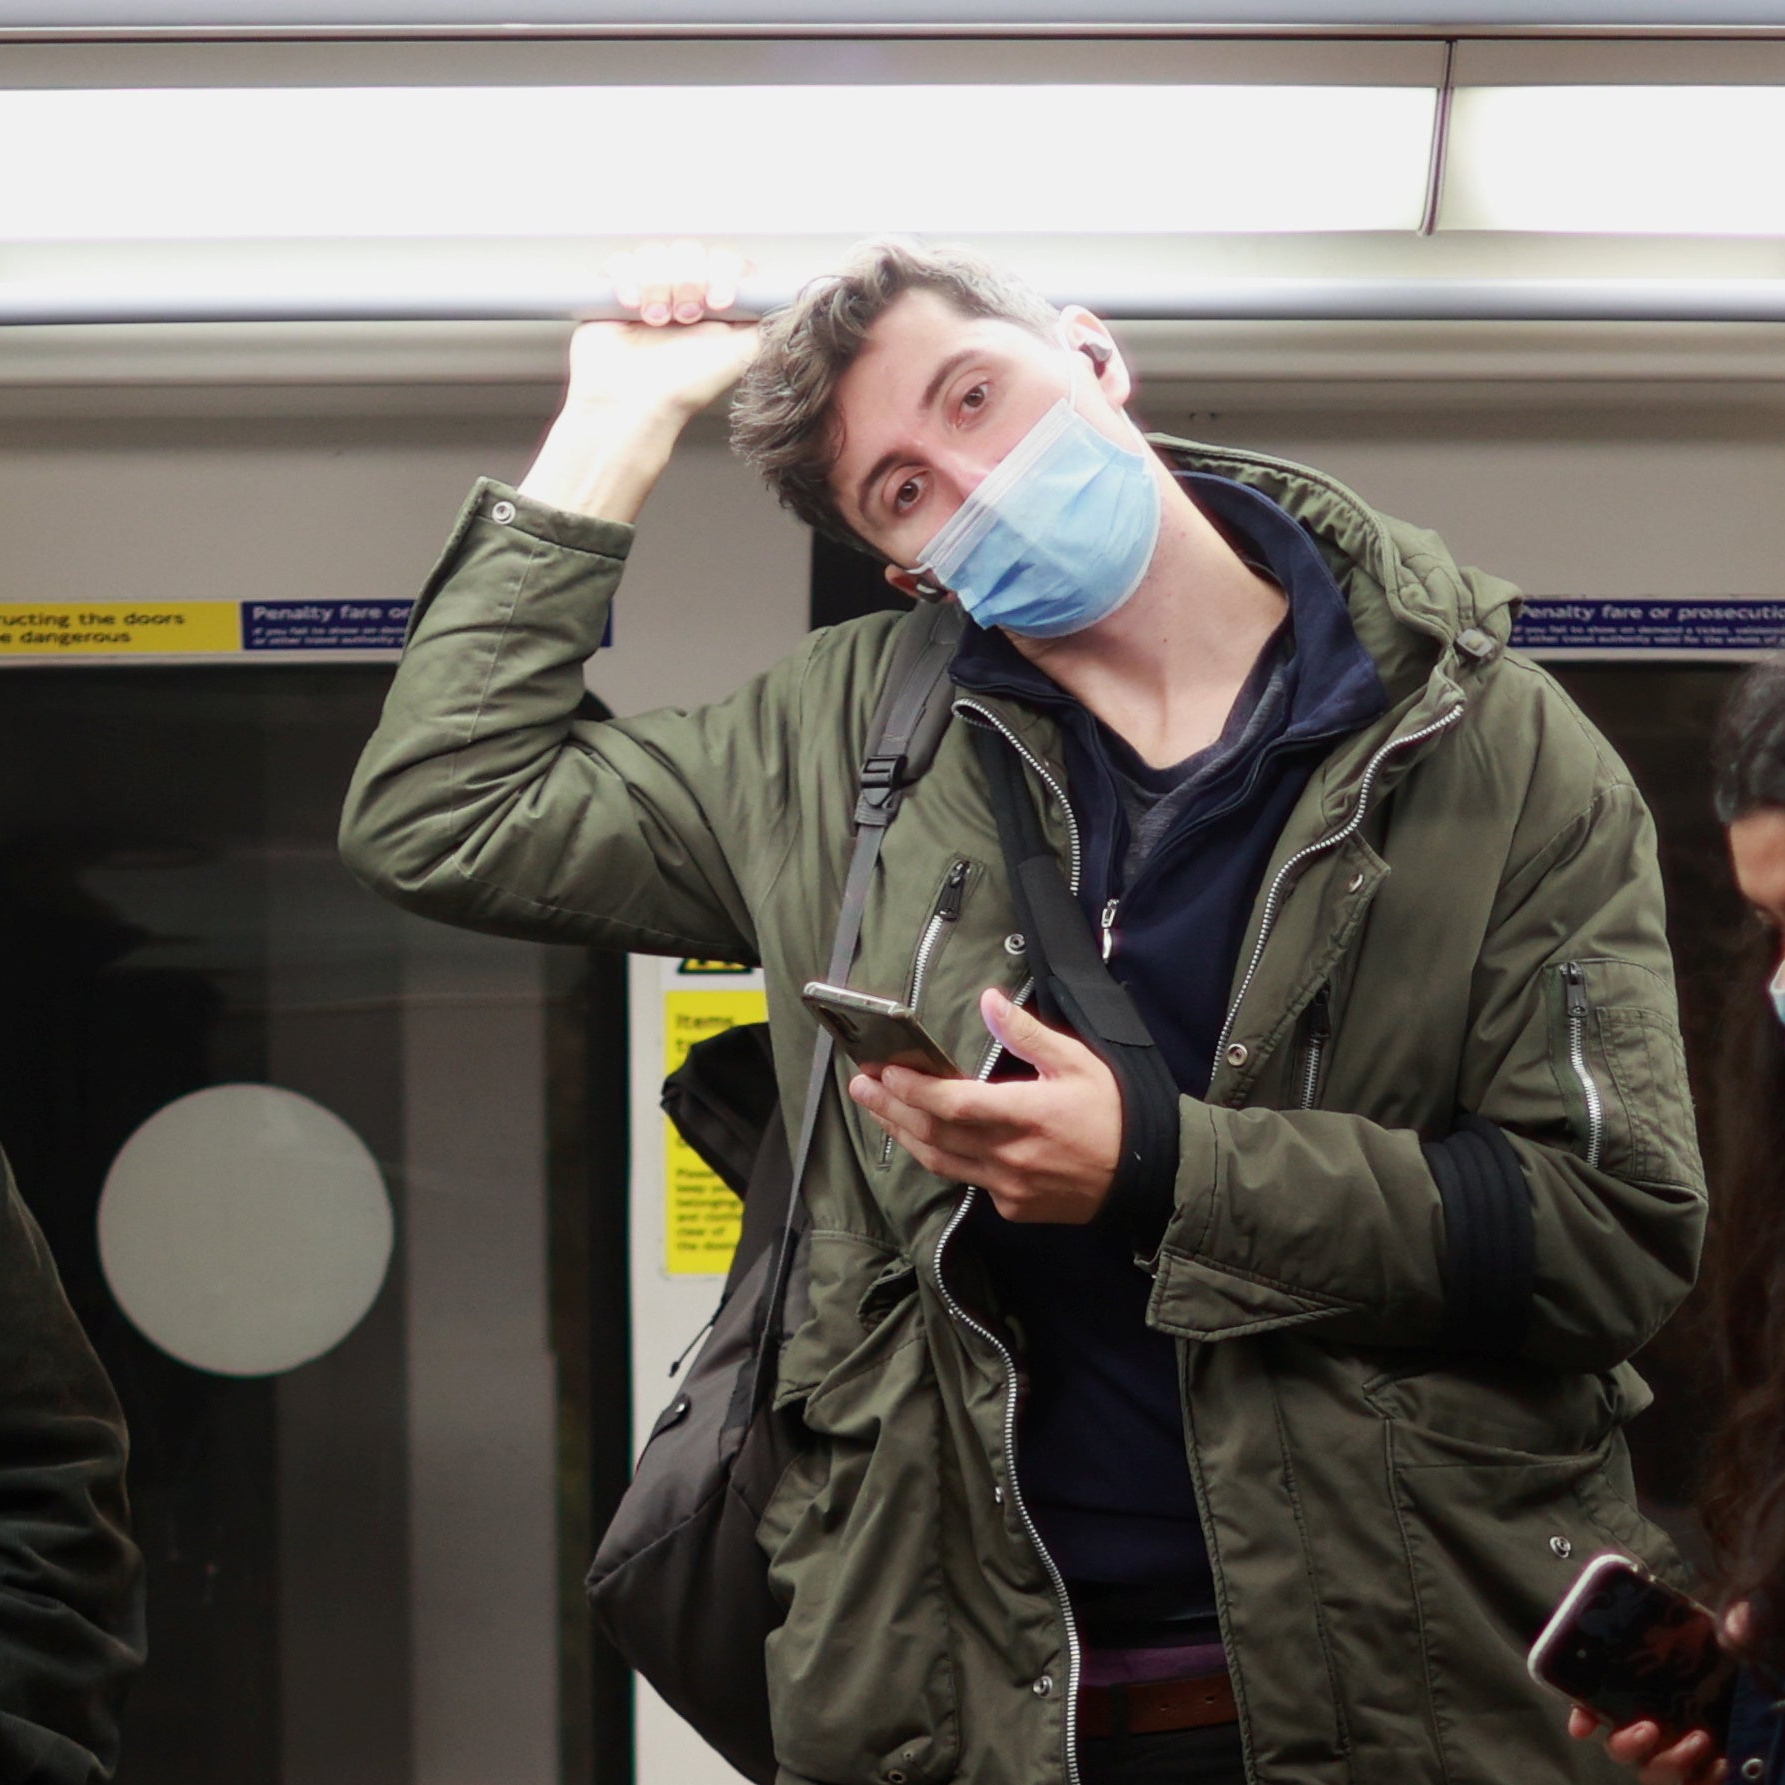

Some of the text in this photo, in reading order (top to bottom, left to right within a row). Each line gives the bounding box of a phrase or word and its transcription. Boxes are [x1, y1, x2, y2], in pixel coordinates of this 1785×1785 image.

[79, 612, 116, 625] the
[123, 612, 185, 625] doors
[252, 604, 334, 623] Penalty
[340, 604, 383, 619] fare
[1602, 603, 1644, 619] fare
[1649, 606, 1672, 619] or
[19, 631, 132, 646] dangerous
